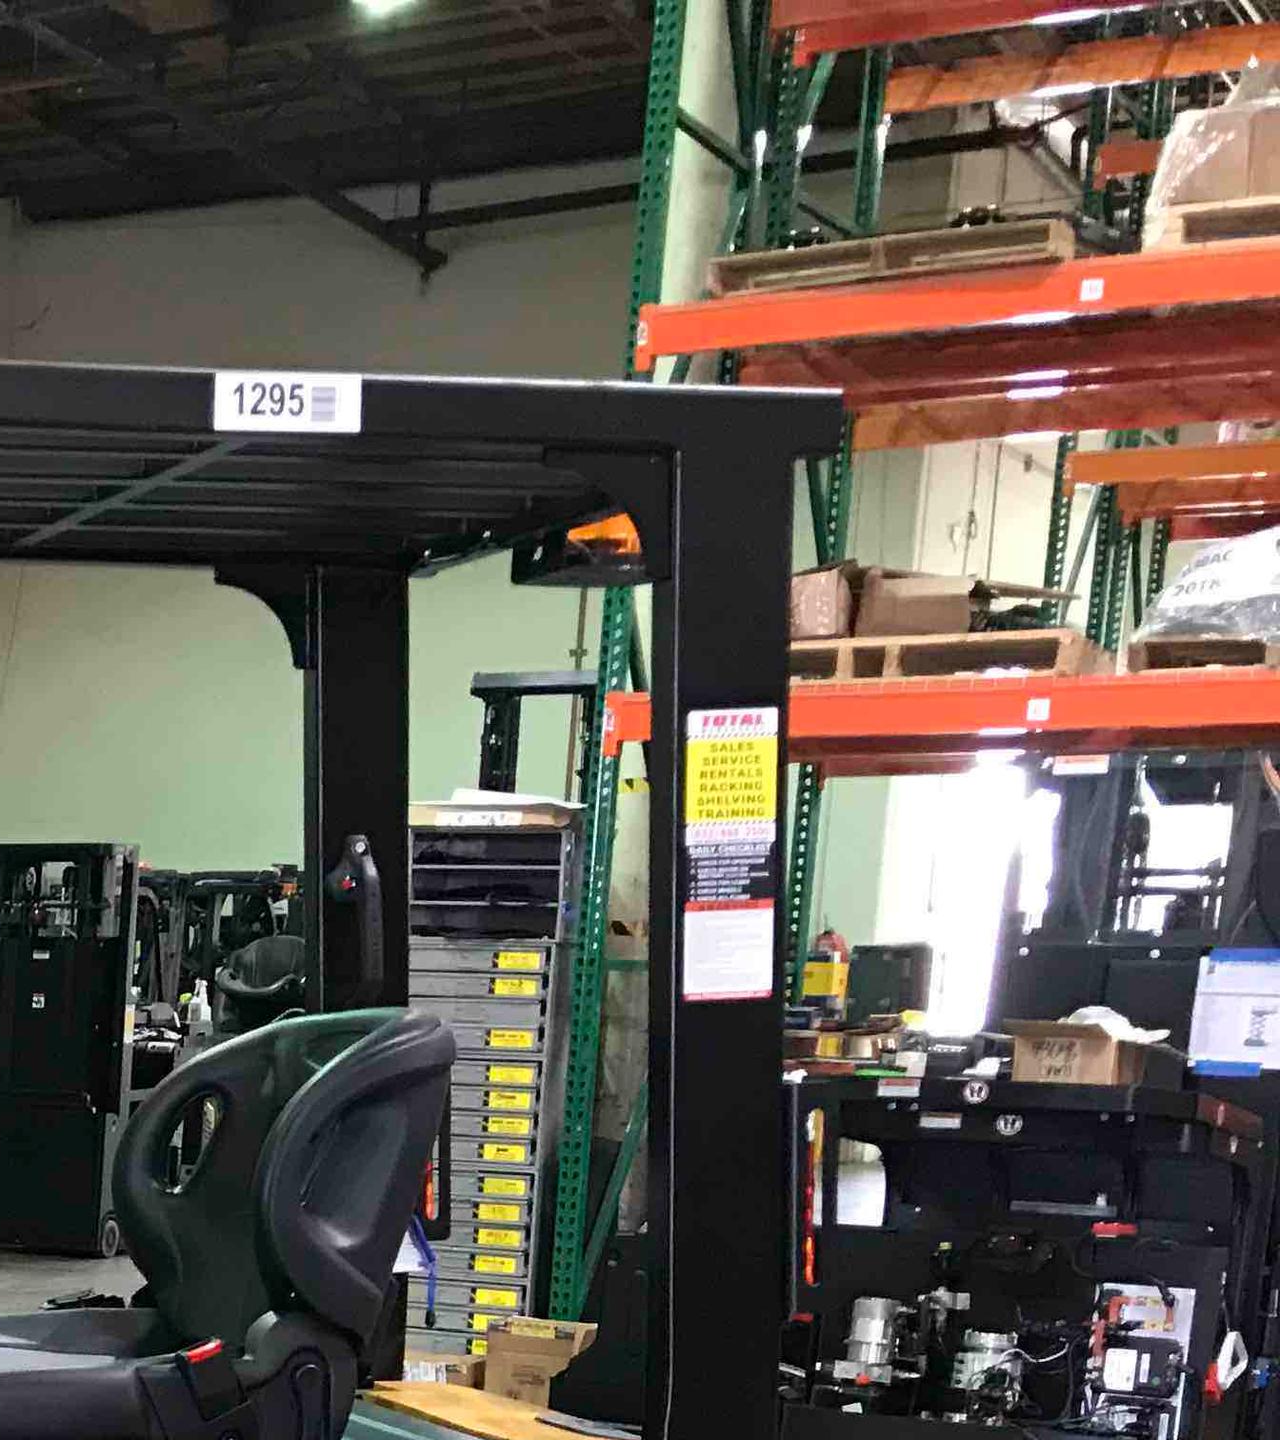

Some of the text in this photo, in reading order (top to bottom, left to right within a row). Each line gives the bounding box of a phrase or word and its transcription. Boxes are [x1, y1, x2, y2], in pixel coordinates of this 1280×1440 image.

[233, 382, 305, 417] 1295
[702, 714, 763, 728] TOTAL
[710, 741, 755, 753] SALES
[702, 754, 762, 767] SERVICE
[699, 768, 763, 780] RENTALS
[699, 781, 763, 793] RACKING
[696, 794, 767, 807] SHELVING
[697, 807, 766, 819] TRAINING
